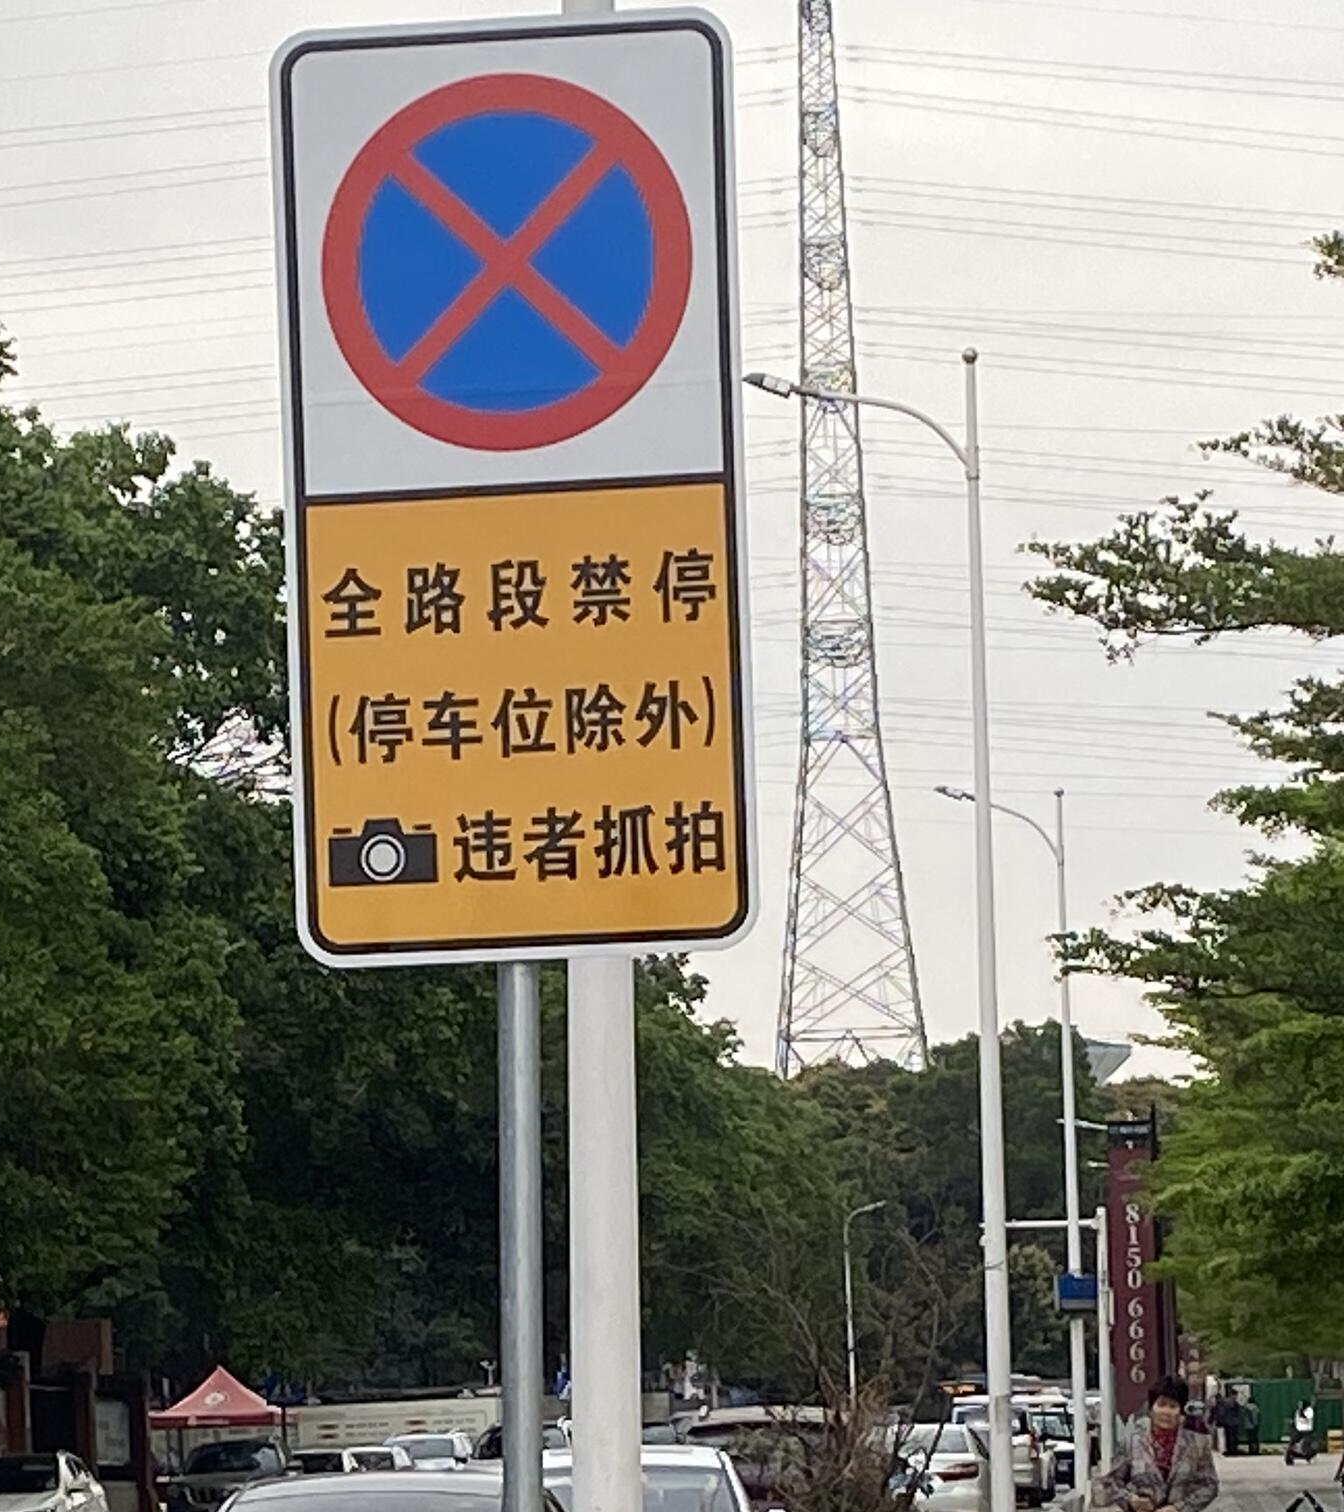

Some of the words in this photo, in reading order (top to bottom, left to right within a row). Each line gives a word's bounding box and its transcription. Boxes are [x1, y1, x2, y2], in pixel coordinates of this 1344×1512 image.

[321, 547, 718, 639] 全路段禁停
[328, 675, 717, 767] (停车位除外)
[452, 800, 728, 884] 违者抓拍
